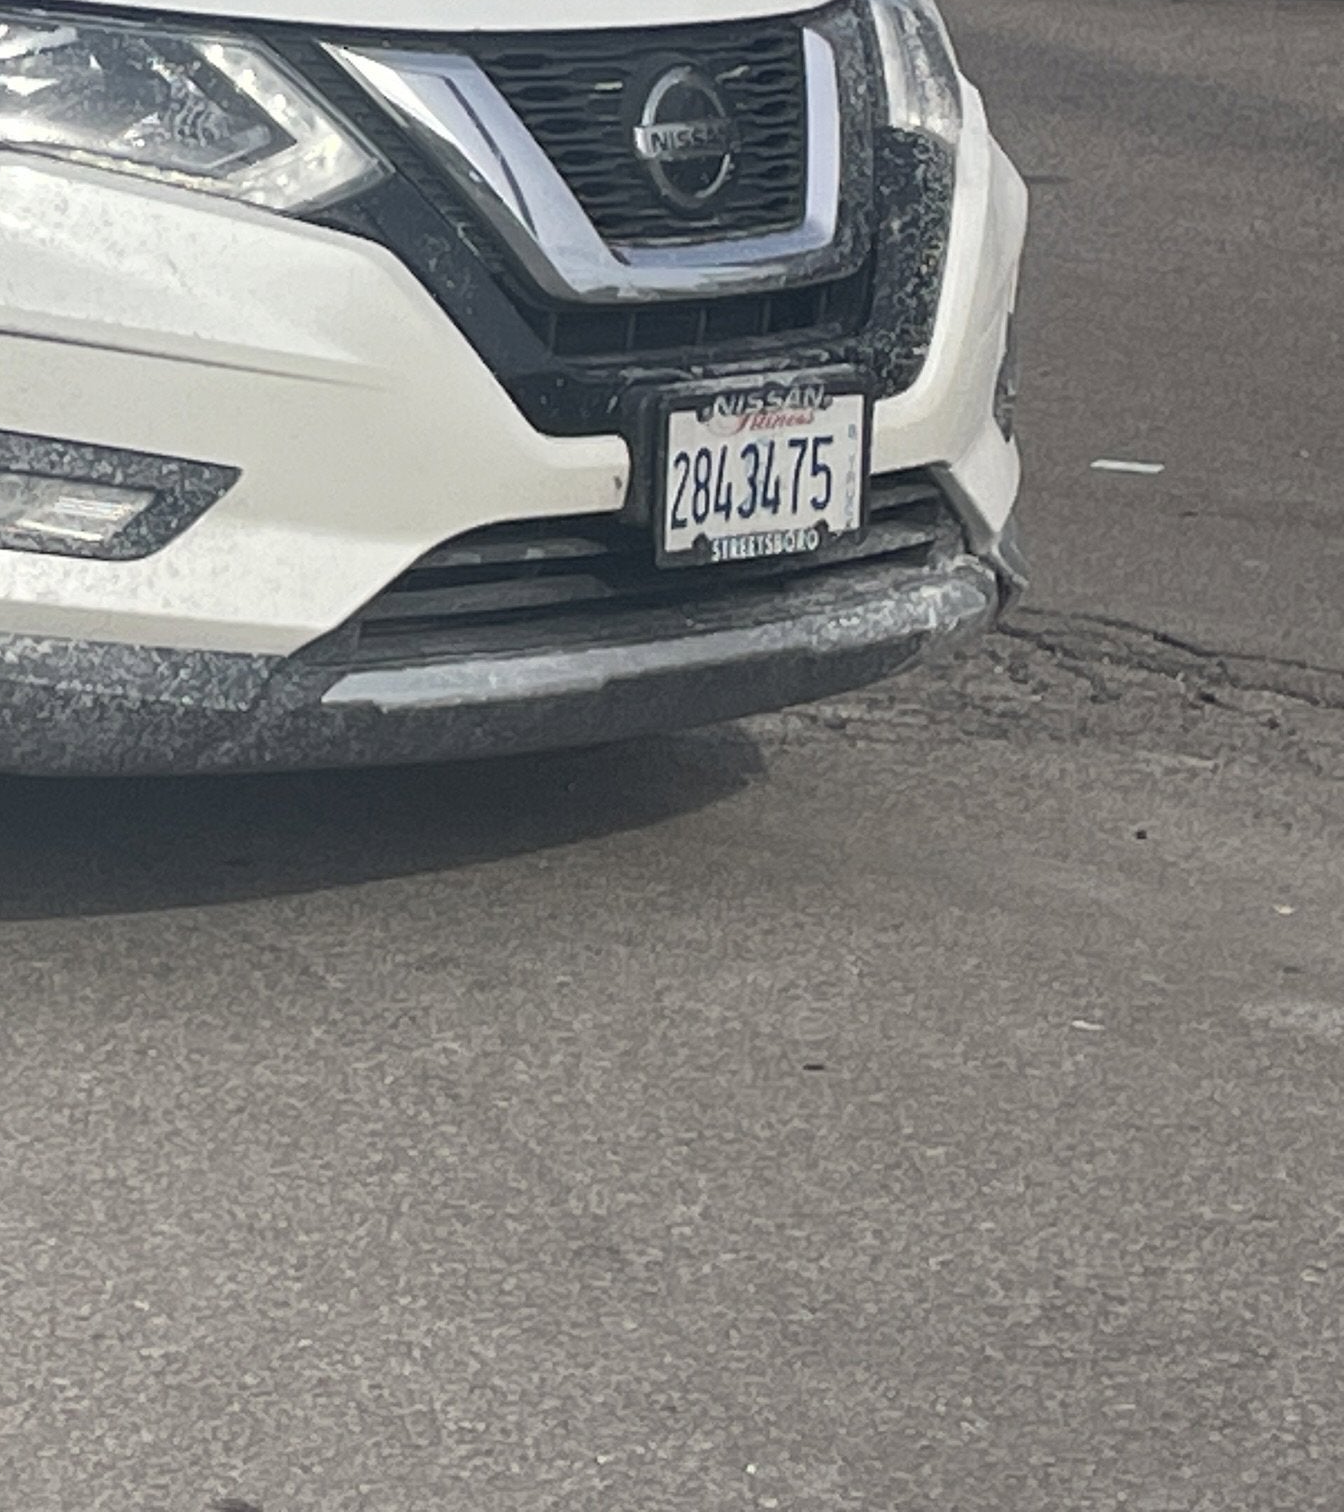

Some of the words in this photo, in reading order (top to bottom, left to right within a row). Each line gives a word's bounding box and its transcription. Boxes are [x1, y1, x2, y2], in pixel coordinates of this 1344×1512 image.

[713, 384, 825, 416] NISSAN
[671, 436, 833, 530] 2843475
[712, 529, 819, 561] STREETSBORO
